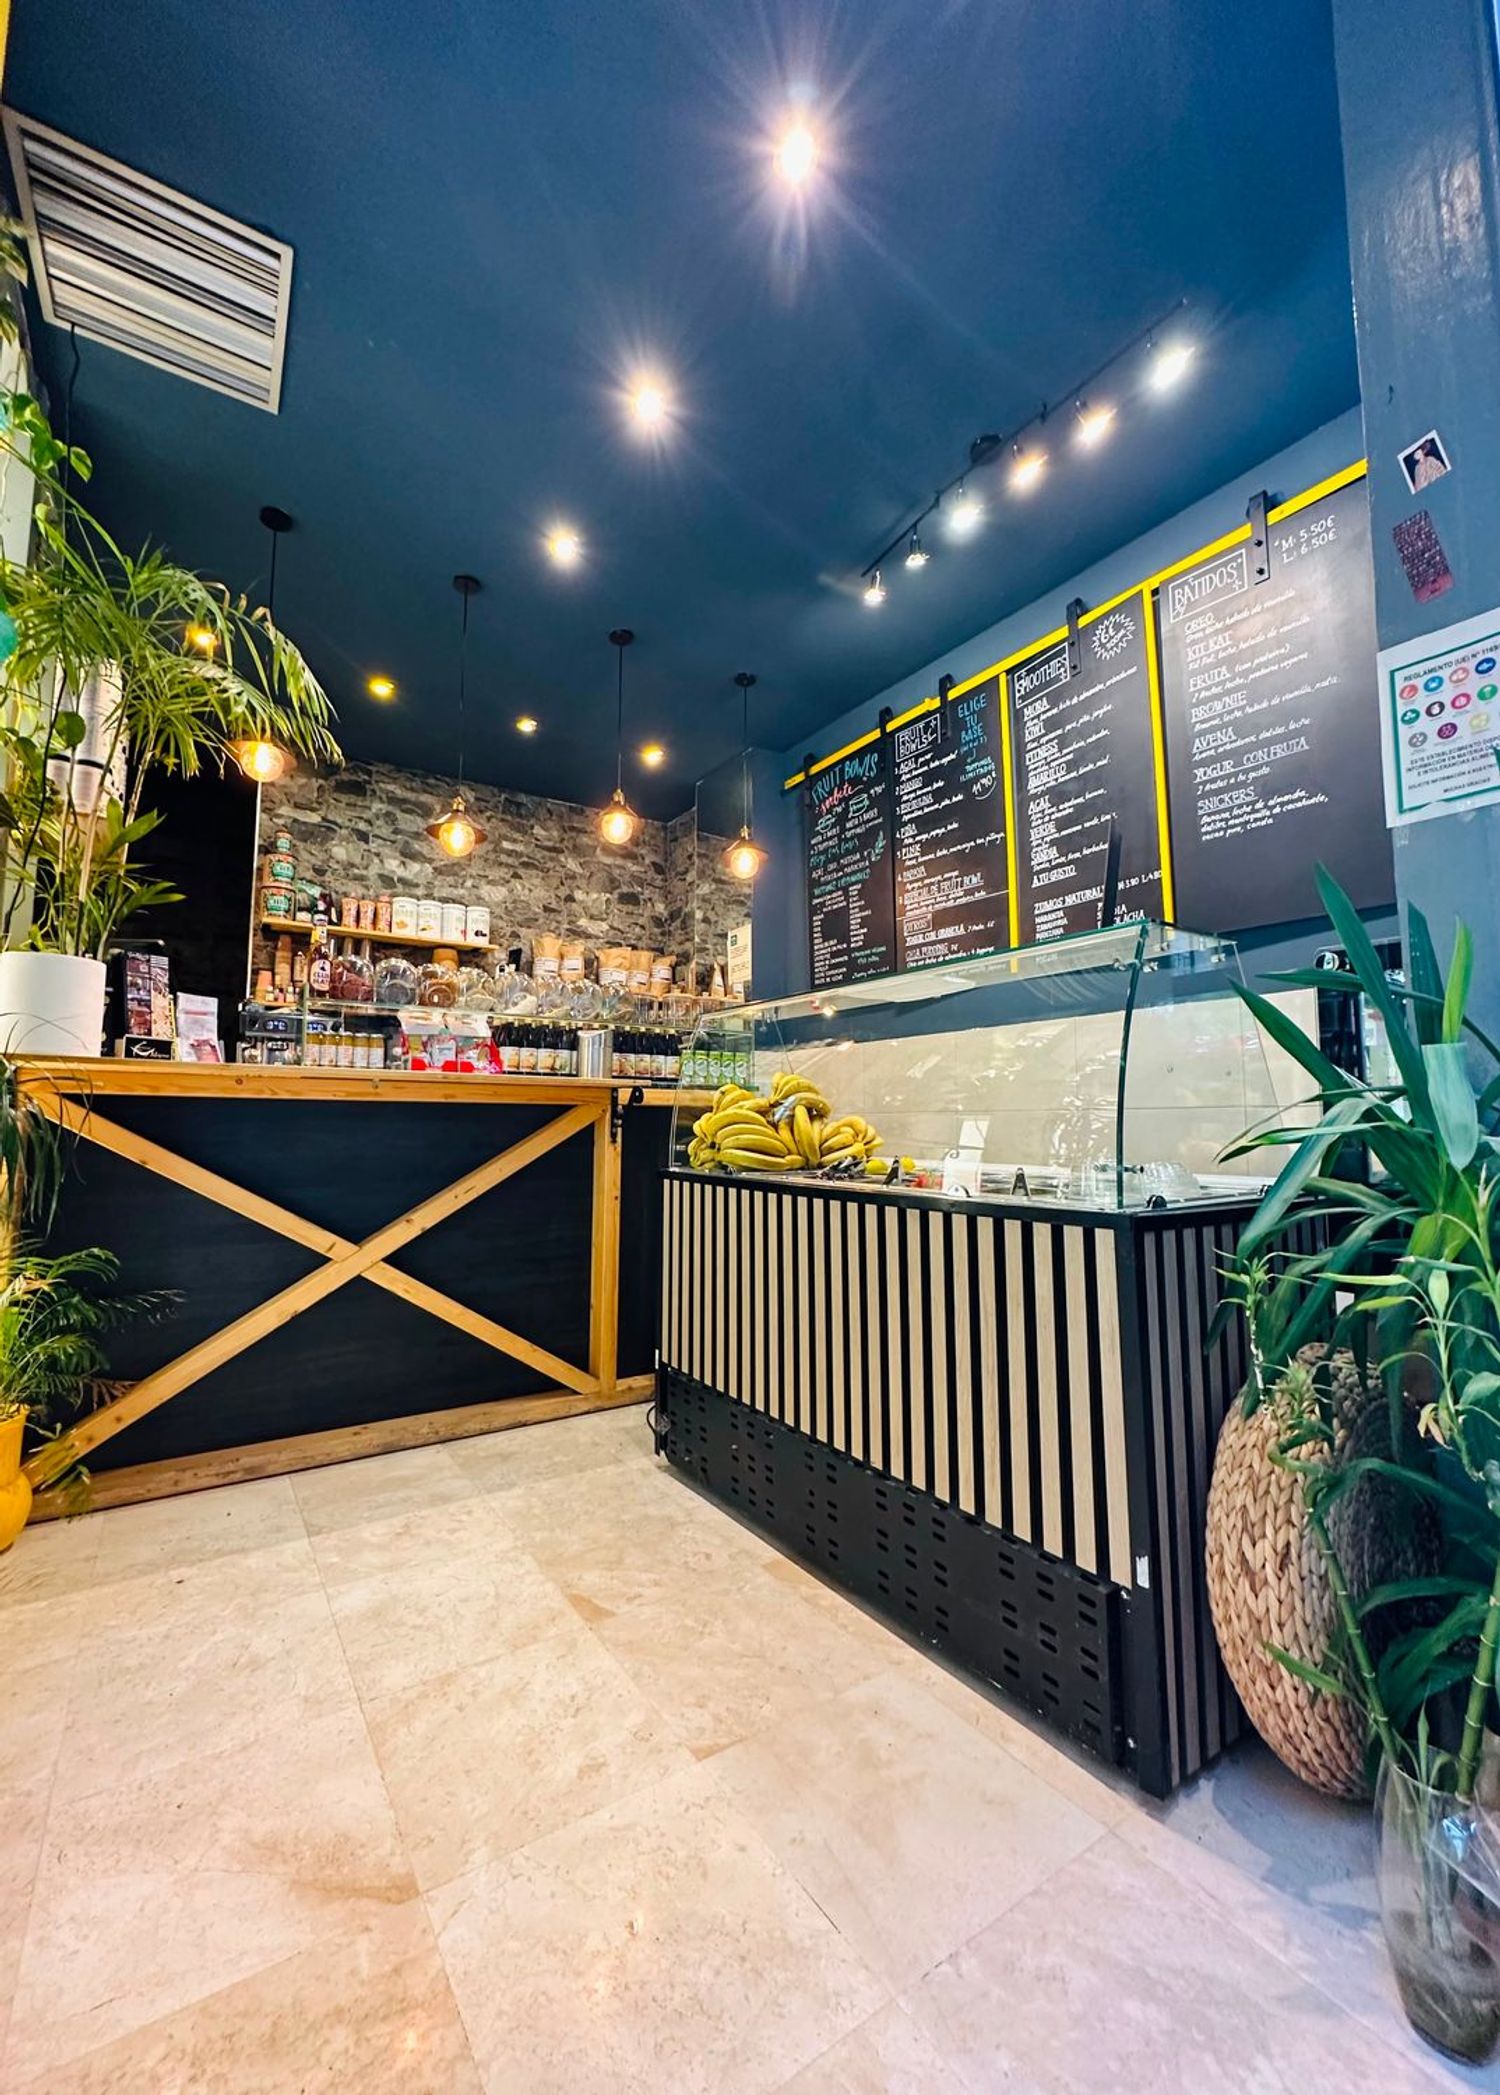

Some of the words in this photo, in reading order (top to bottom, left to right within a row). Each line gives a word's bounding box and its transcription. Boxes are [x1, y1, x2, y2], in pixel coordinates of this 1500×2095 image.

[1299, 515, 1334, 541] 5.50€
[1300, 528, 1335, 553] 6.50€
[1175, 562, 1236, 608] BATIDOS
[1017, 653, 1068, 696] SMOOTHIES
[1189, 665, 1229, 690] FRUTA
[1403, 661, 1452, 681] REGLAMENTO
[1454, 655, 1469, 665] (UE)
[958, 693, 985, 717] ELIGE
[1191, 691, 1246, 721] BROWNIE
[961, 722, 982, 742] BASE
[965, 714, 977, 727] TU
[899, 723, 923, 745] FRUIT
[899, 734, 927, 756] BOWLS
[1192, 727, 1235, 752] AVENA
[1025, 739, 1057, 764] FITNESS
[1193, 760, 1233, 782] YOGUR
[1243, 748, 1268, 767] CON
[1270, 736, 1308, 759] FRUTA
[812, 764, 841, 804] FRUIT
[844, 753, 878, 780] BOWLS
[1027, 763, 1066, 789] AMARILLO
[1197, 786, 1254, 813] SNICKERS
[940, 877, 961, 893] FRUIT
[1034, 897, 1063, 913] ZUMOS
[1064, 885, 1104, 905] NATURAL
